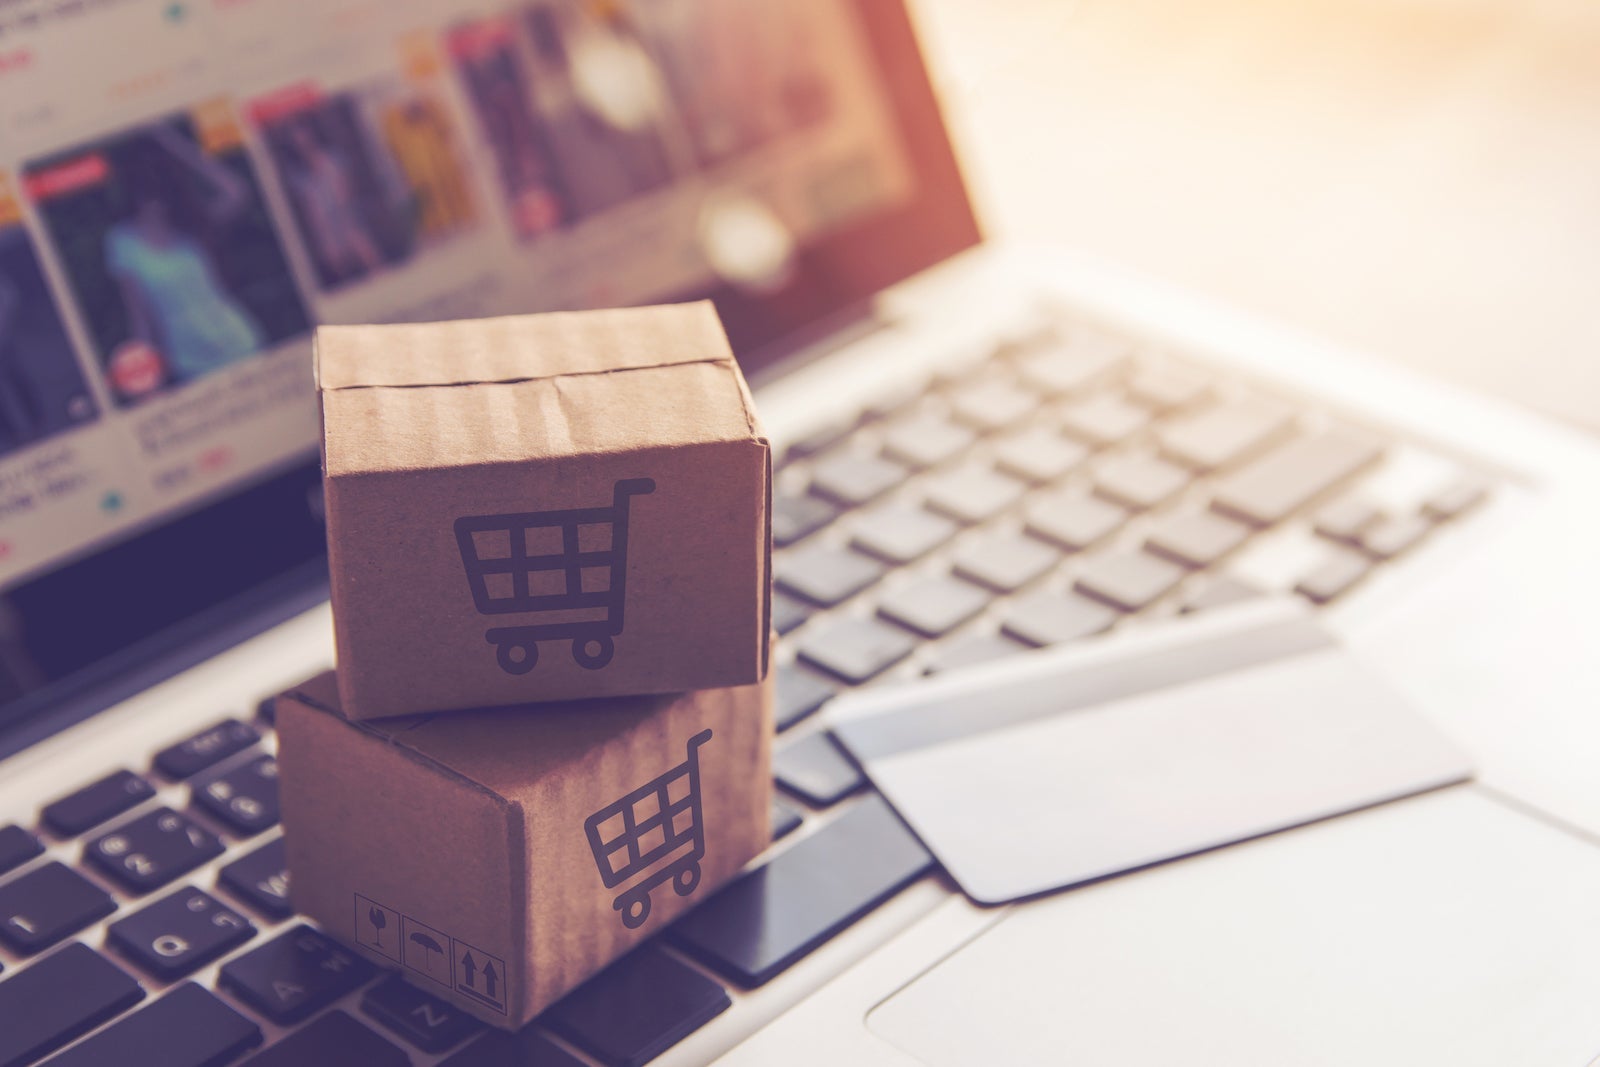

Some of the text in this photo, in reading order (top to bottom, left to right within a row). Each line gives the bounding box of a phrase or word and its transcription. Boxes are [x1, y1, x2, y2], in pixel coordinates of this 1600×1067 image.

[152, 935, 190, 957] Q
[272, 978, 305, 1001] A
[410, 1004, 449, 1027] Z
